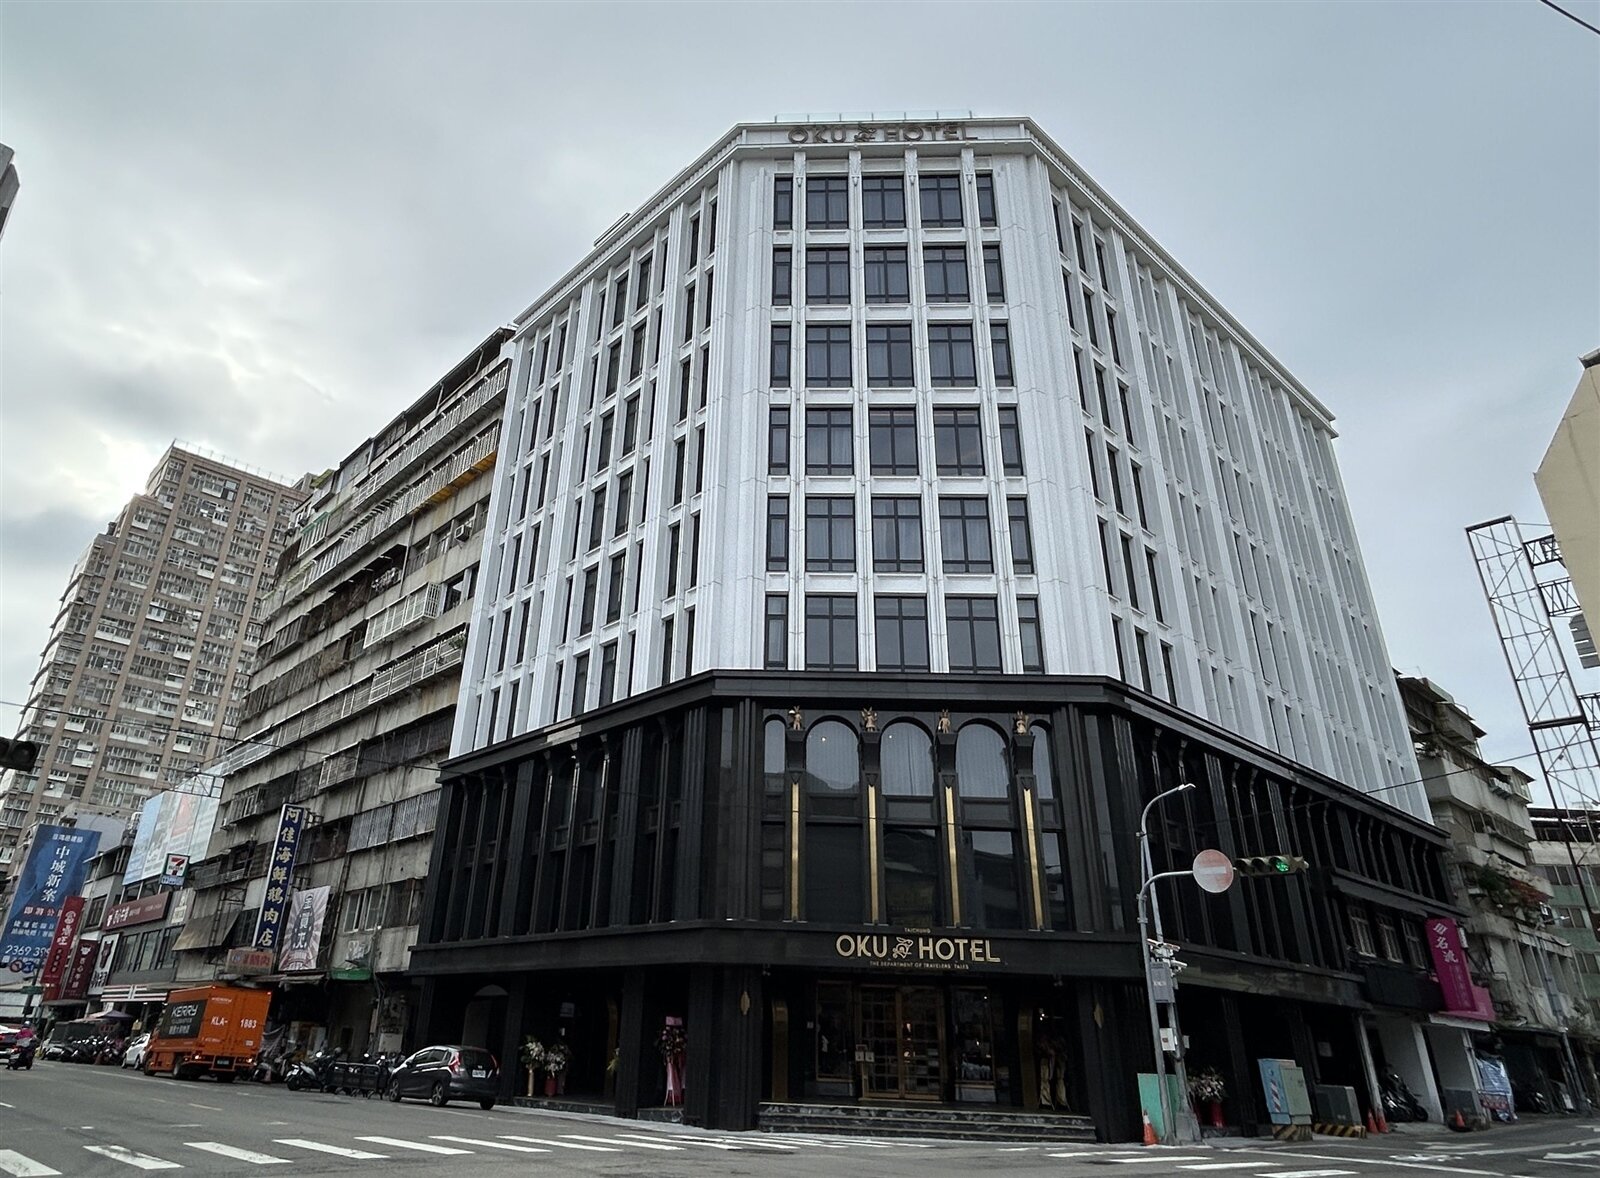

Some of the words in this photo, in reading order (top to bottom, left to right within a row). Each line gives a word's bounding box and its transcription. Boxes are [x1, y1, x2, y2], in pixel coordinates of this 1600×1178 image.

[788, 125, 847, 144] OKU
[884, 122, 978, 143] HOTEL
[41, 845, 71, 903] 中城新案
[836, 934, 888, 958] OKU
[918, 937, 1001, 963] HOTEL
[171, 1004, 199, 1017] KERRY
